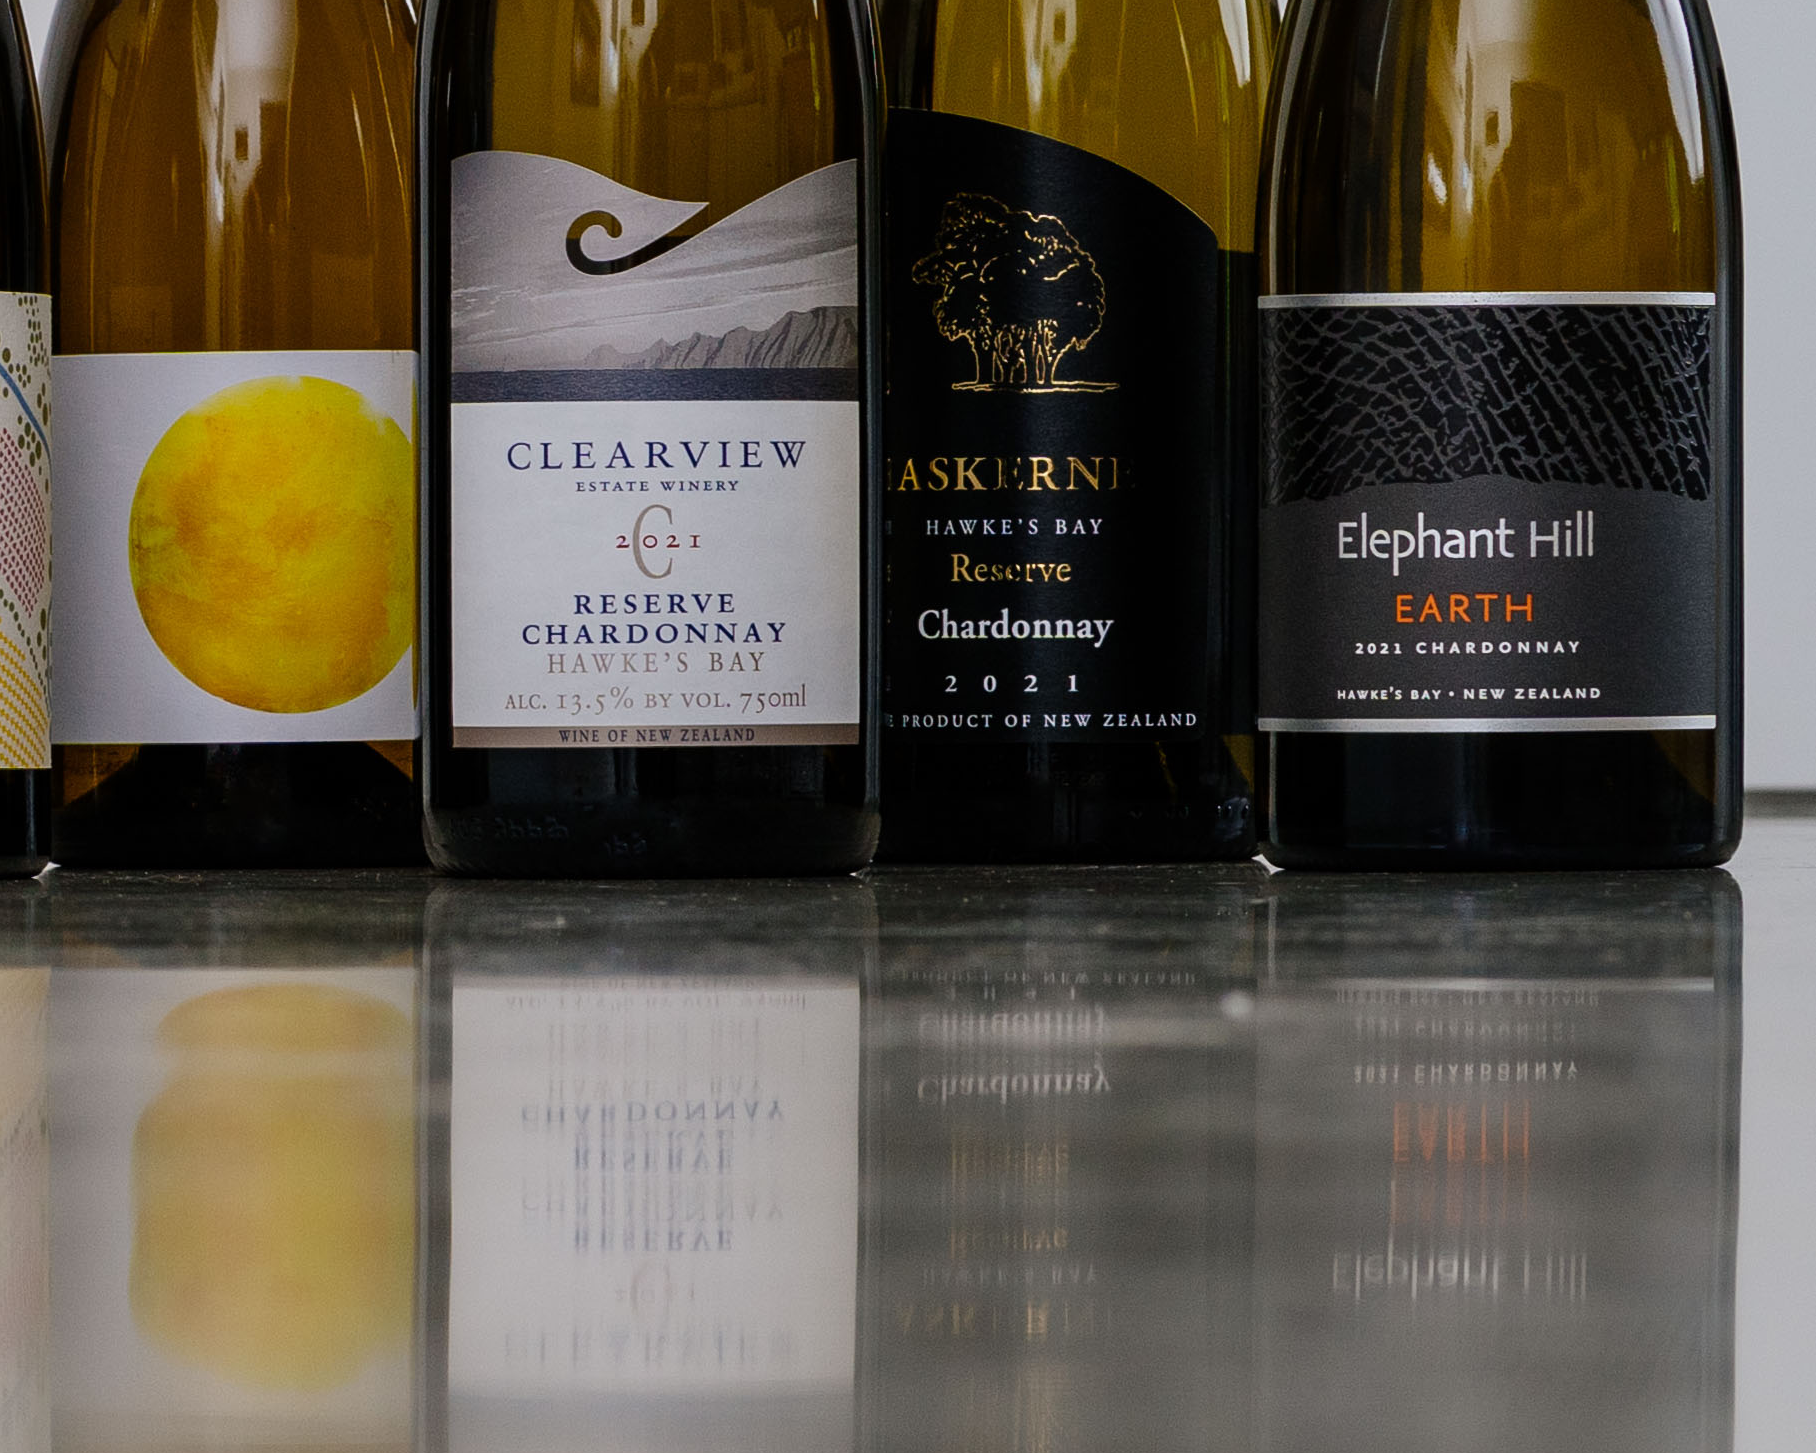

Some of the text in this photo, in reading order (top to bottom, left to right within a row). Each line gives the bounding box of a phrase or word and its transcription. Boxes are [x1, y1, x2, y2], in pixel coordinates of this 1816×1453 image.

[507, 440, 806, 471] CLEARVIEW
[576, 480, 740, 493] ESTATE WINERY
[926, 518, 1104, 536] HAWKE'S BAY
[616, 534, 701, 550] 2021
[1338, 510, 1594, 576] Elephant Hill
[951, 553, 1072, 583] Reserve
[573, 593, 735, 615] RESERVE
[1396, 593, 1534, 623] EARTH
[521, 622, 787, 645] CHARDONNAY
[918, 608, 1115, 648] Chardonnay
[1355, 641, 1580, 655] 2021 CHARDONNAY
[547, 652, 765, 674] HAWKE'S BAY
[504, 684, 807, 715] ALC. 13.5% BY VOL. 750ml
[1337, 686, 1601, 700] HAWKE'S BAY NEW ZEALAND
[903, 712, 1197, 728] PRODUCT OF NEW ZEALAND
[559, 728, 756, 743] WINE OF NEW ZEALAND
